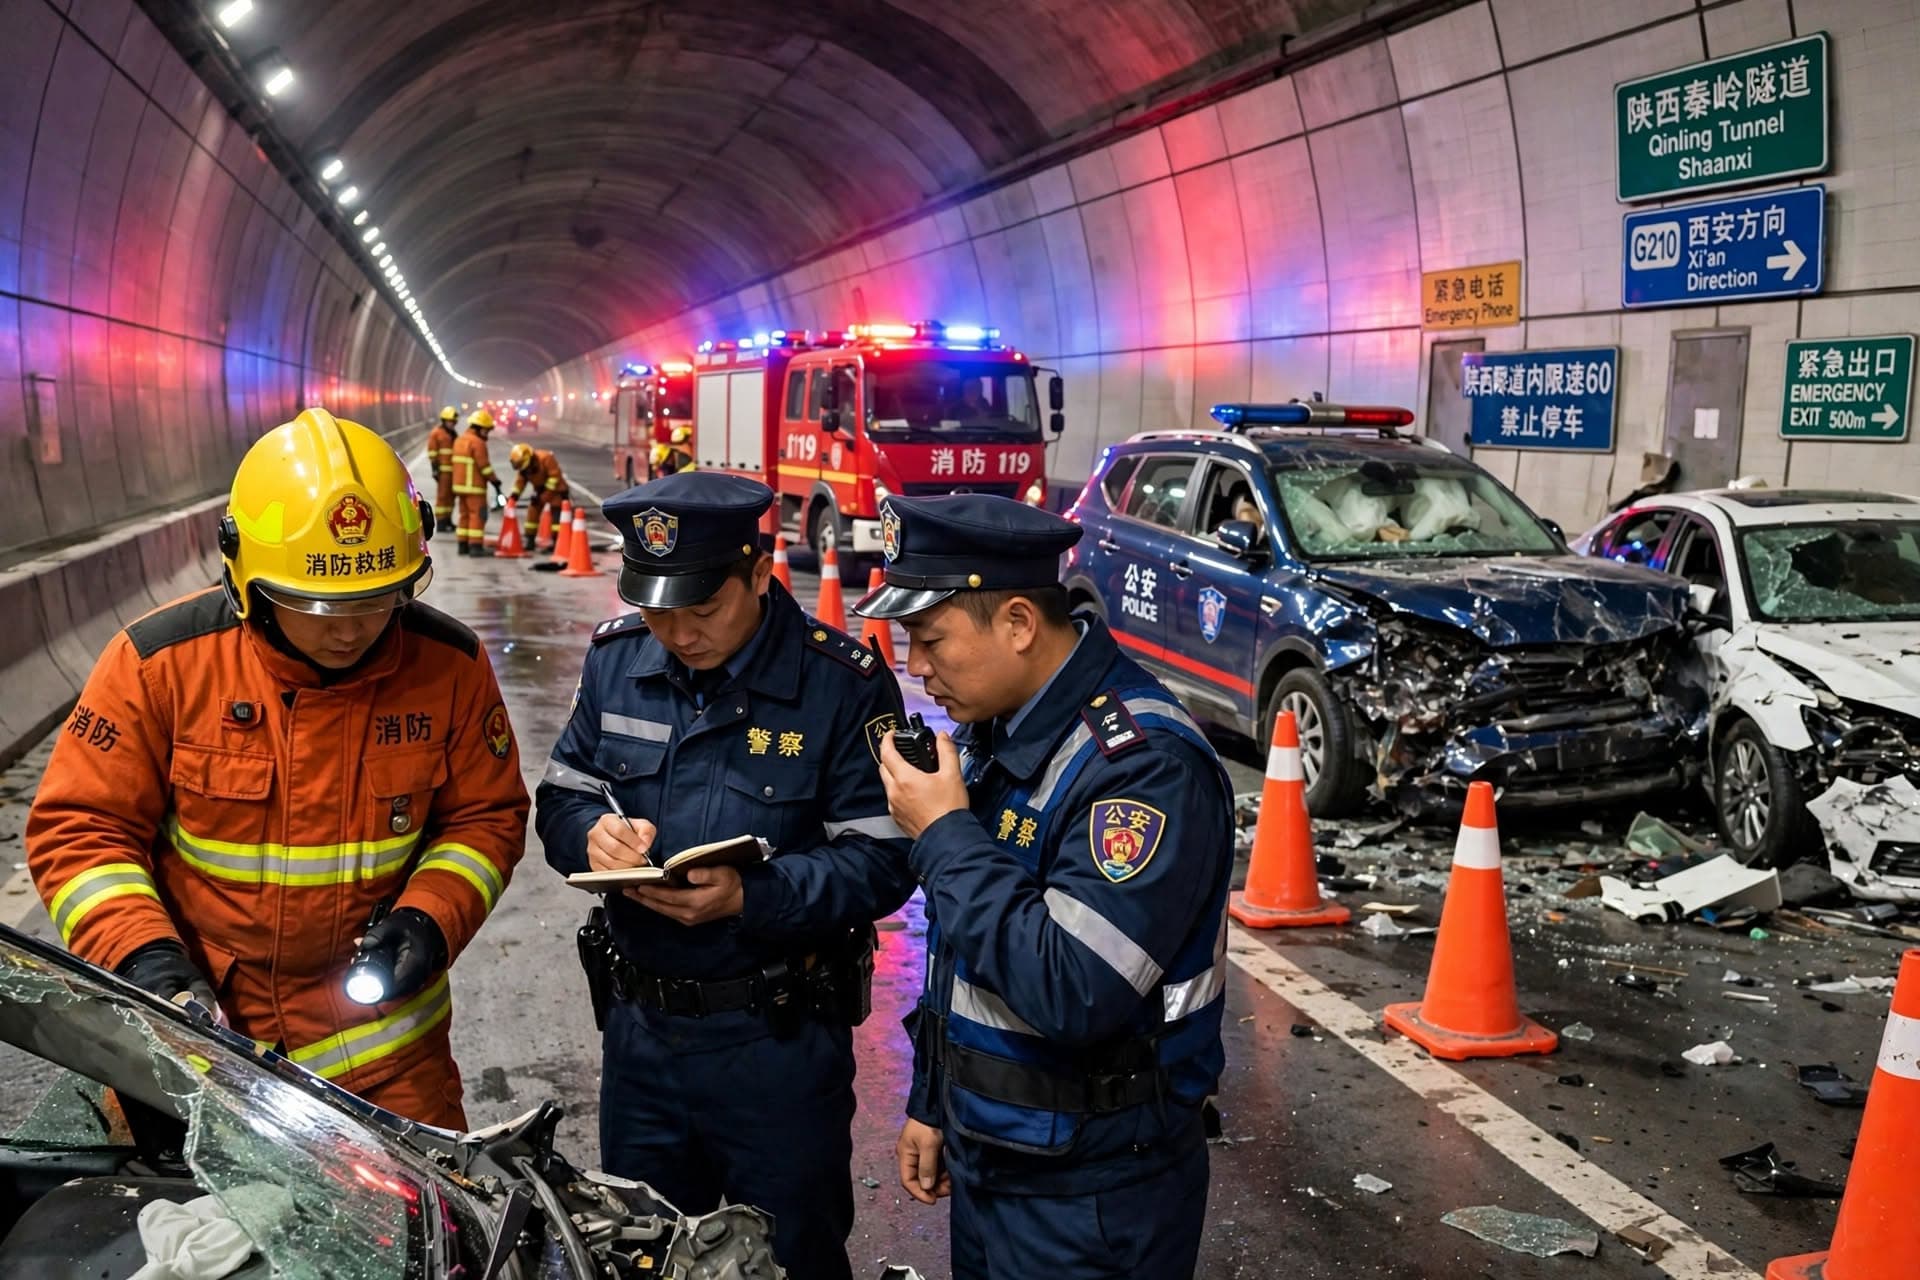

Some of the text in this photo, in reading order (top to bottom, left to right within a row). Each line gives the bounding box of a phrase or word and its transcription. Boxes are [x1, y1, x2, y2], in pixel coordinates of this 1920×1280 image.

[1627, 54, 1811, 134] 陕西秦岭隧道
[1648, 109, 1784, 156] Qinling Tunnel
[1678, 146, 1752, 180] Shaanxi
[1688, 204, 1785, 247] 西安方向
[1634, 229, 1677, 262] G210
[1688, 250, 1725, 270] Xi'an
[1434, 272, 1504, 303] 紧急电话
[1687, 269, 1758, 291] Direction
[1425, 302, 1513, 325] Emergency Phone
[1798, 347, 1896, 379] 紧急出口
[1790, 382, 1886, 403] EMERGENCY
[1500, 404, 1584, 440] 禁止停车
[1790, 407, 1866, 429] EXIT 500m
[930, 447, 1031, 475] 消防 119
[306, 545, 396, 576] 消防救援
[1124, 563, 1157, 600] 公安
[1121, 595, 1158, 623] POLICE
[67, 704, 122, 752] 消防
[375, 712, 432, 745] 消防
[747, 727, 803, 757] 警察
[997, 808, 1038, 848] 警察
[1105, 805, 1151, 832] 公安
